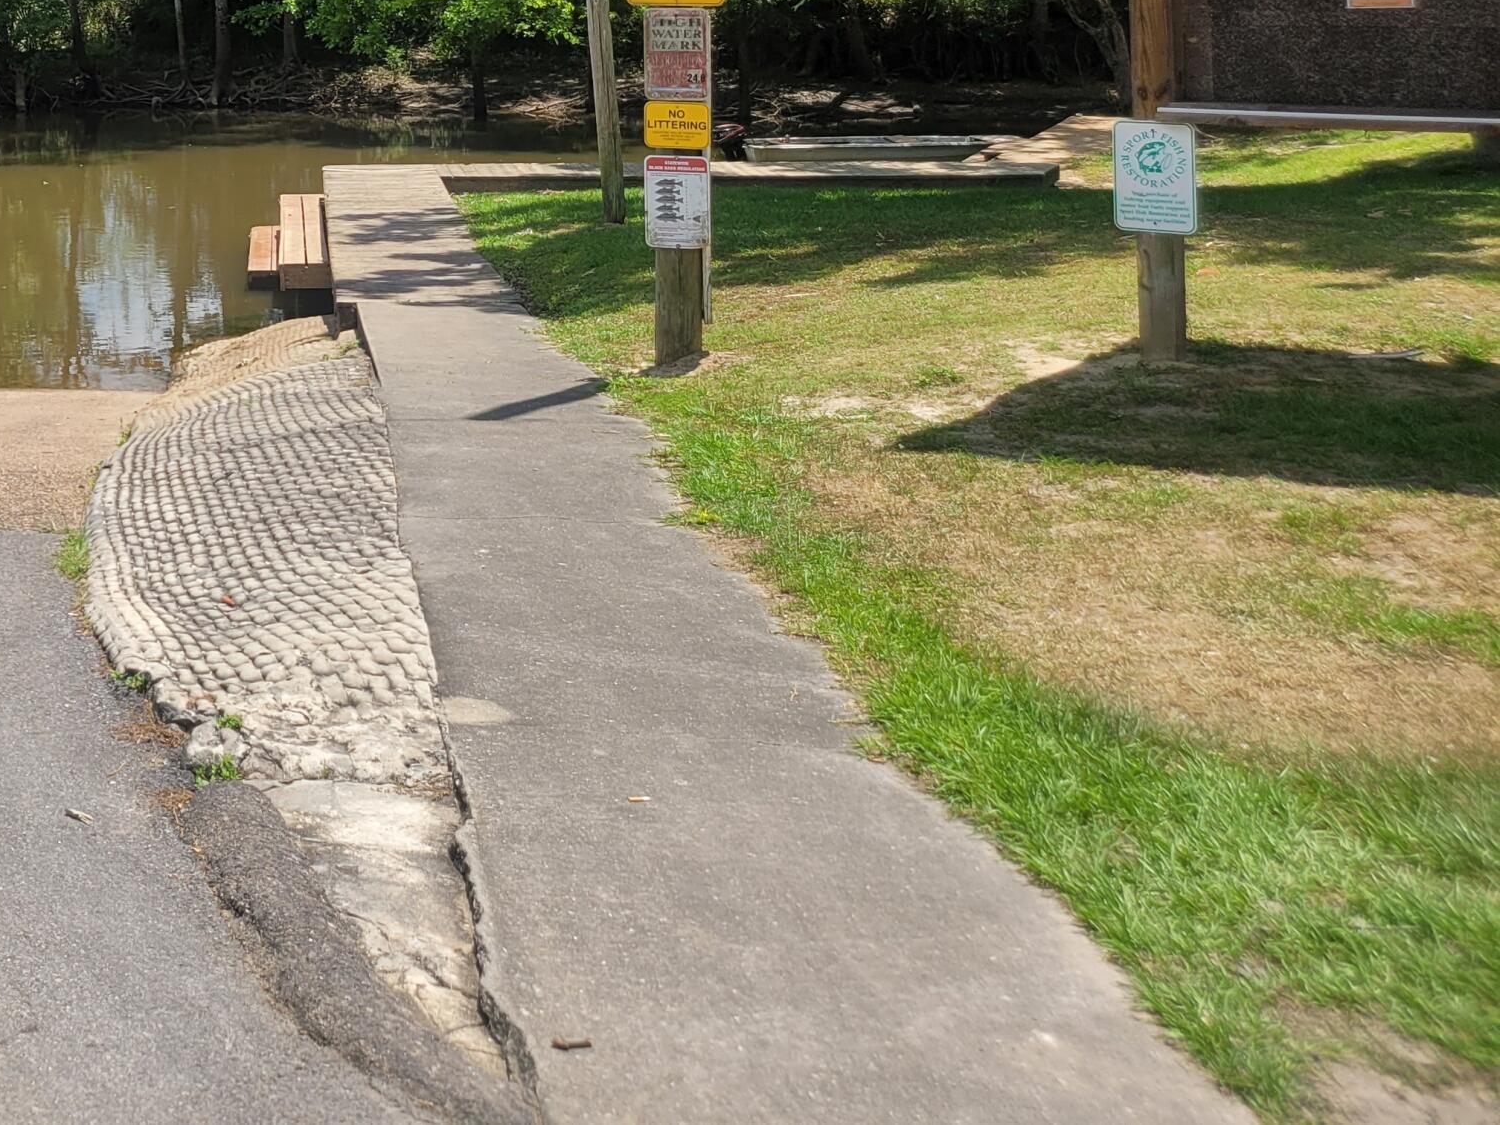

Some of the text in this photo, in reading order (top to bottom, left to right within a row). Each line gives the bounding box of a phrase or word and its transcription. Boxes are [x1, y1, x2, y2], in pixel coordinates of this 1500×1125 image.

[652, 29, 702, 38] WATER
[652, 40, 702, 50] MARK
[668, 109, 685, 118] NO
[647, 119, 707, 131] LITTERING
[1123, 129, 1185, 155] SPORT FISH
[1121, 155, 1187, 188] RESTORATION
